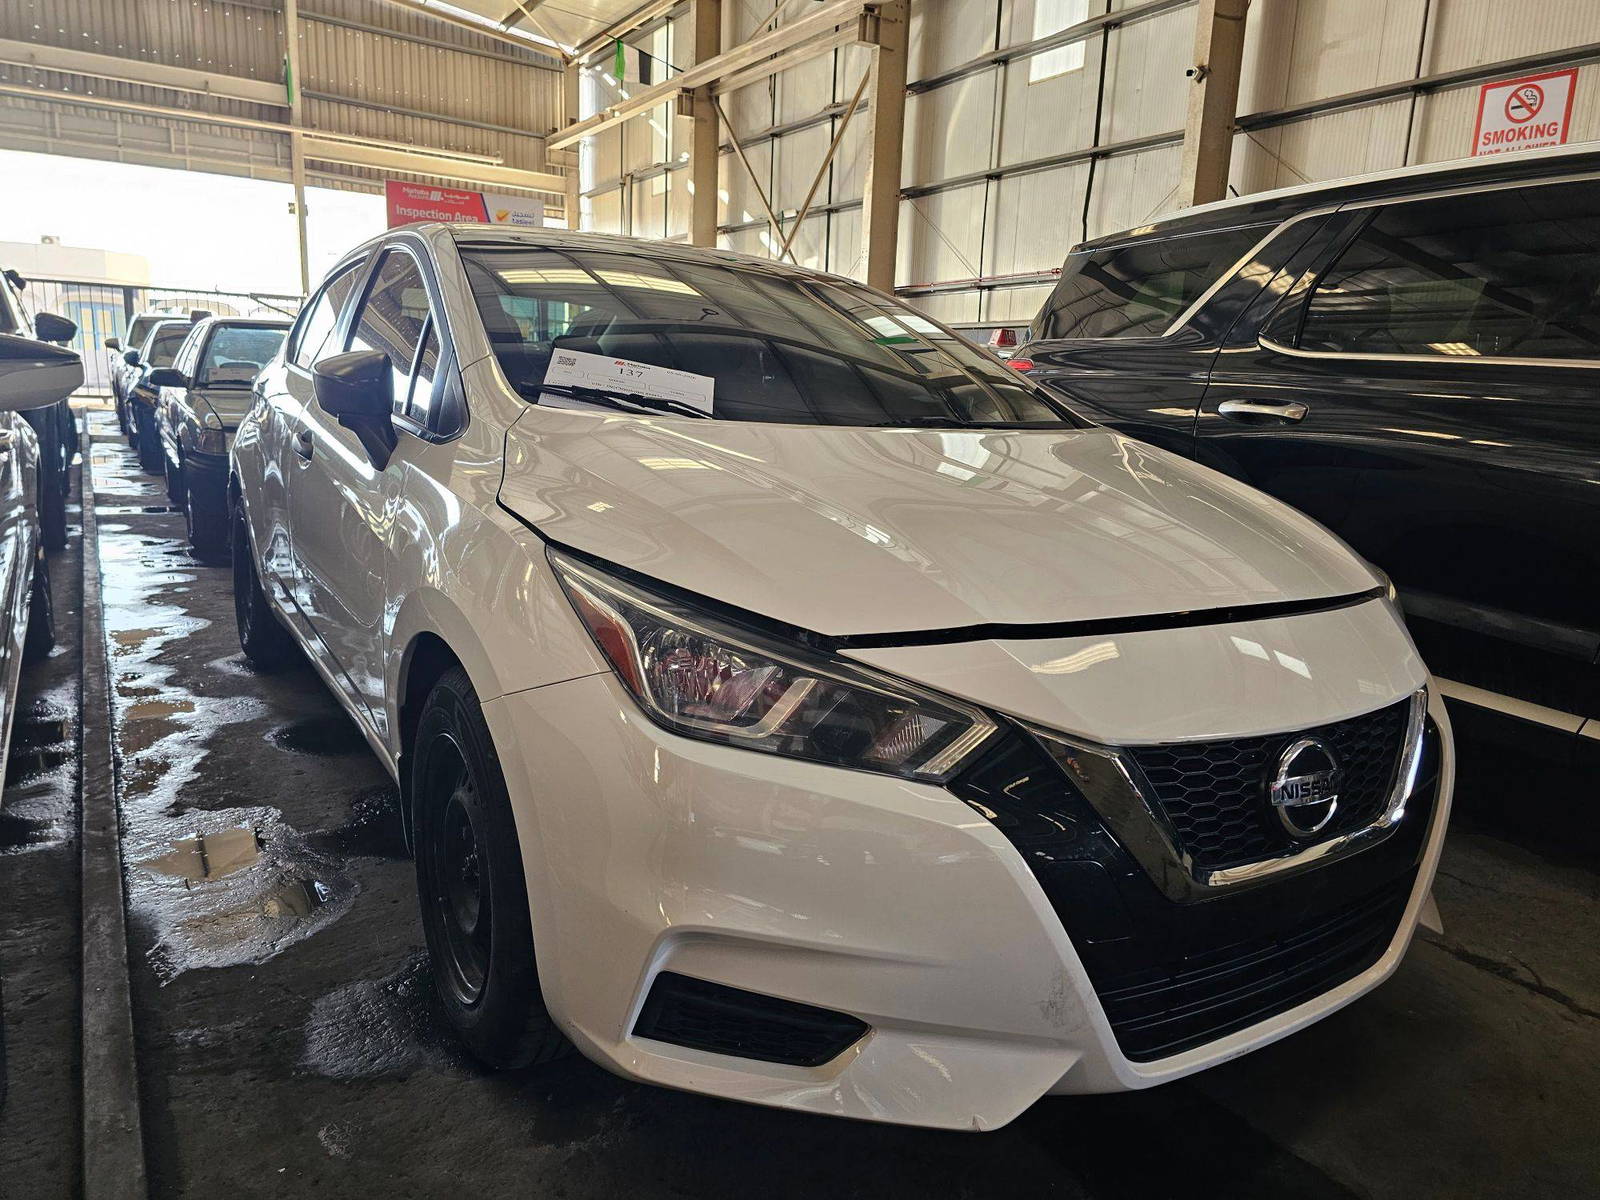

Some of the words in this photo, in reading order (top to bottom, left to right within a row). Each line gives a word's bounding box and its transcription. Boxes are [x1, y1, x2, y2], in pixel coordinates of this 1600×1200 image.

[1482, 121, 1558, 146] SMOKING
[396, 204, 451, 221] Inspection
[454, 211, 478, 223] Area
[618, 367, 643, 378] 137
[1281, 777, 1335, 801] NISSA
